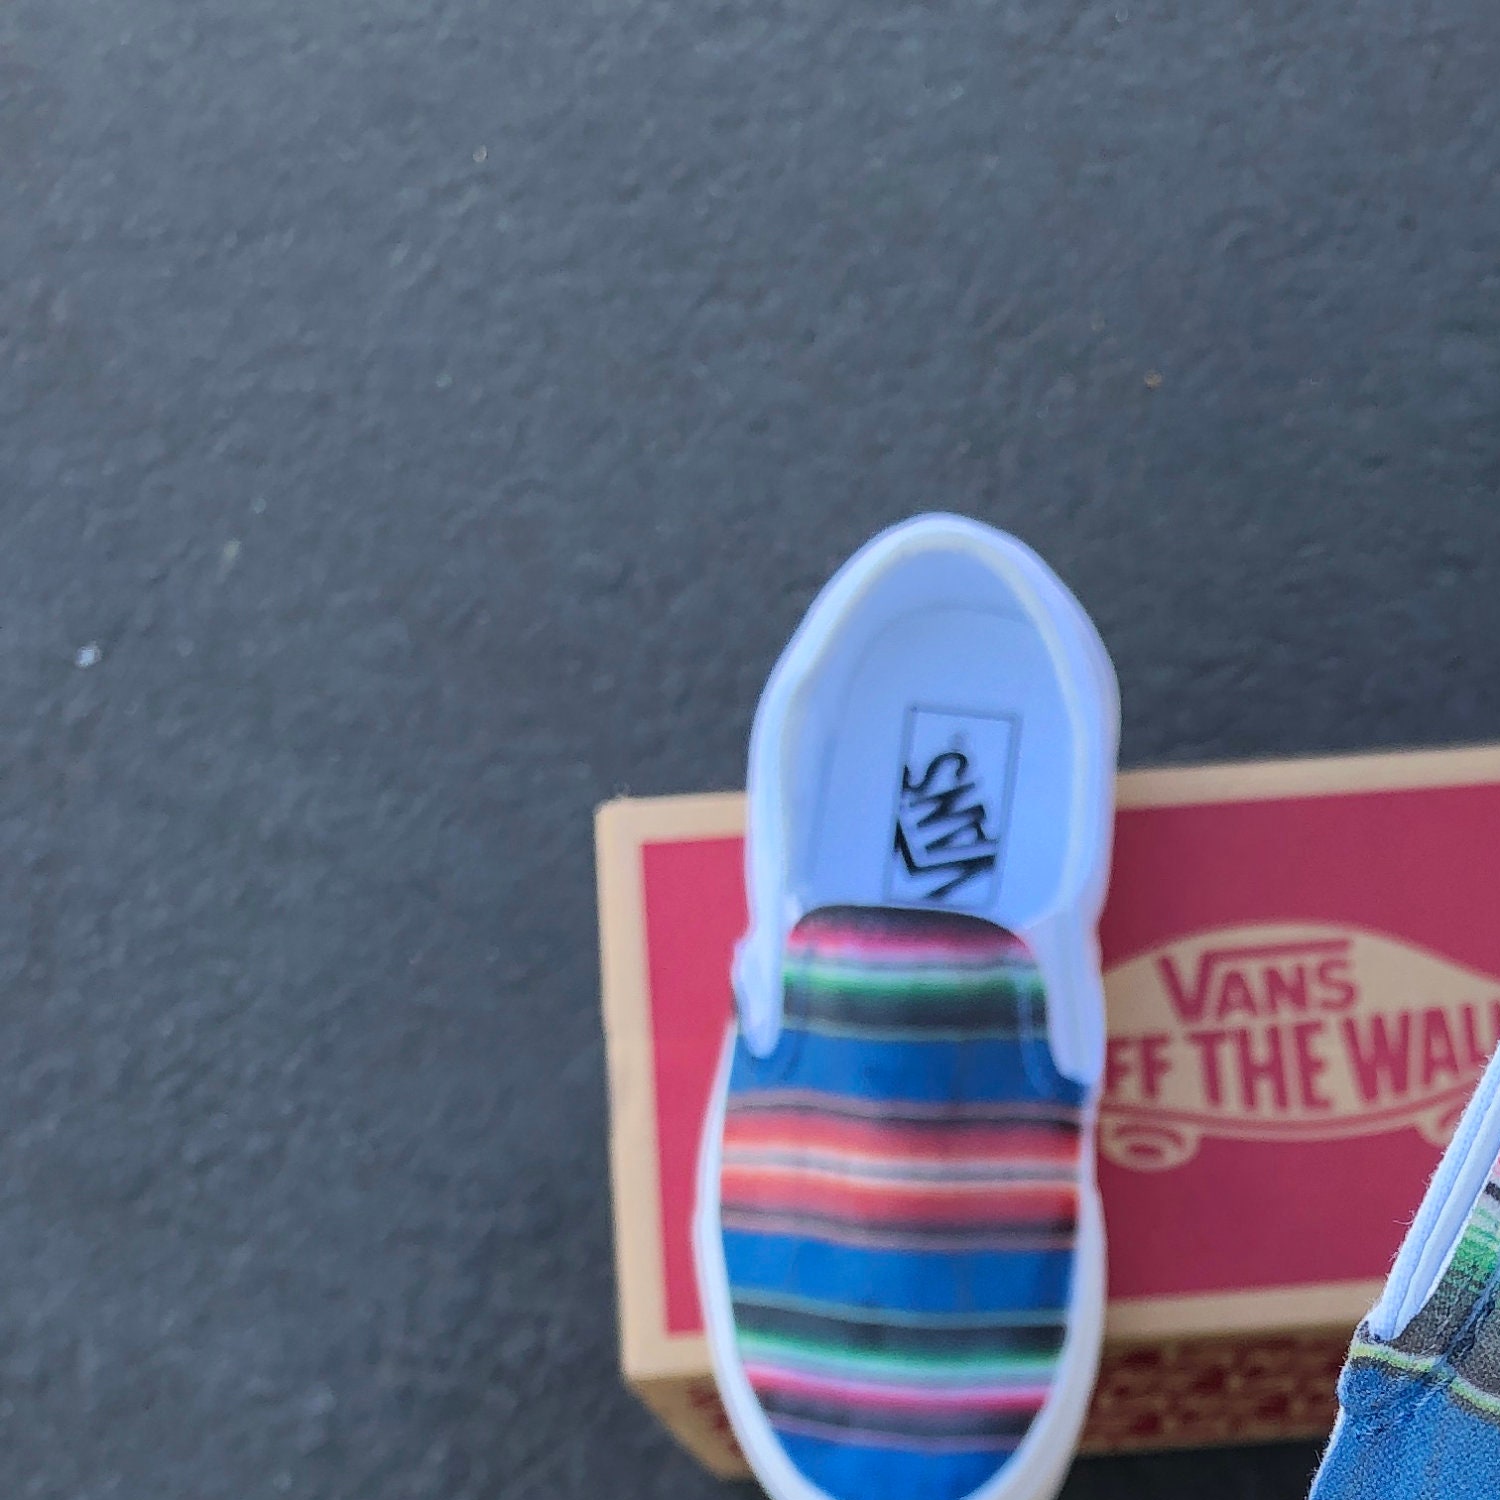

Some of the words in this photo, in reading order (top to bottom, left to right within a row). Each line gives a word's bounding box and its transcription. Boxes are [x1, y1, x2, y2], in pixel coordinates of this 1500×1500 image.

[894, 752, 998, 901] VANS
[1157, 938, 1359, 1021] VANS
[1105, 1033, 1172, 1098] FF
[1186, 1023, 1333, 1109] THE
